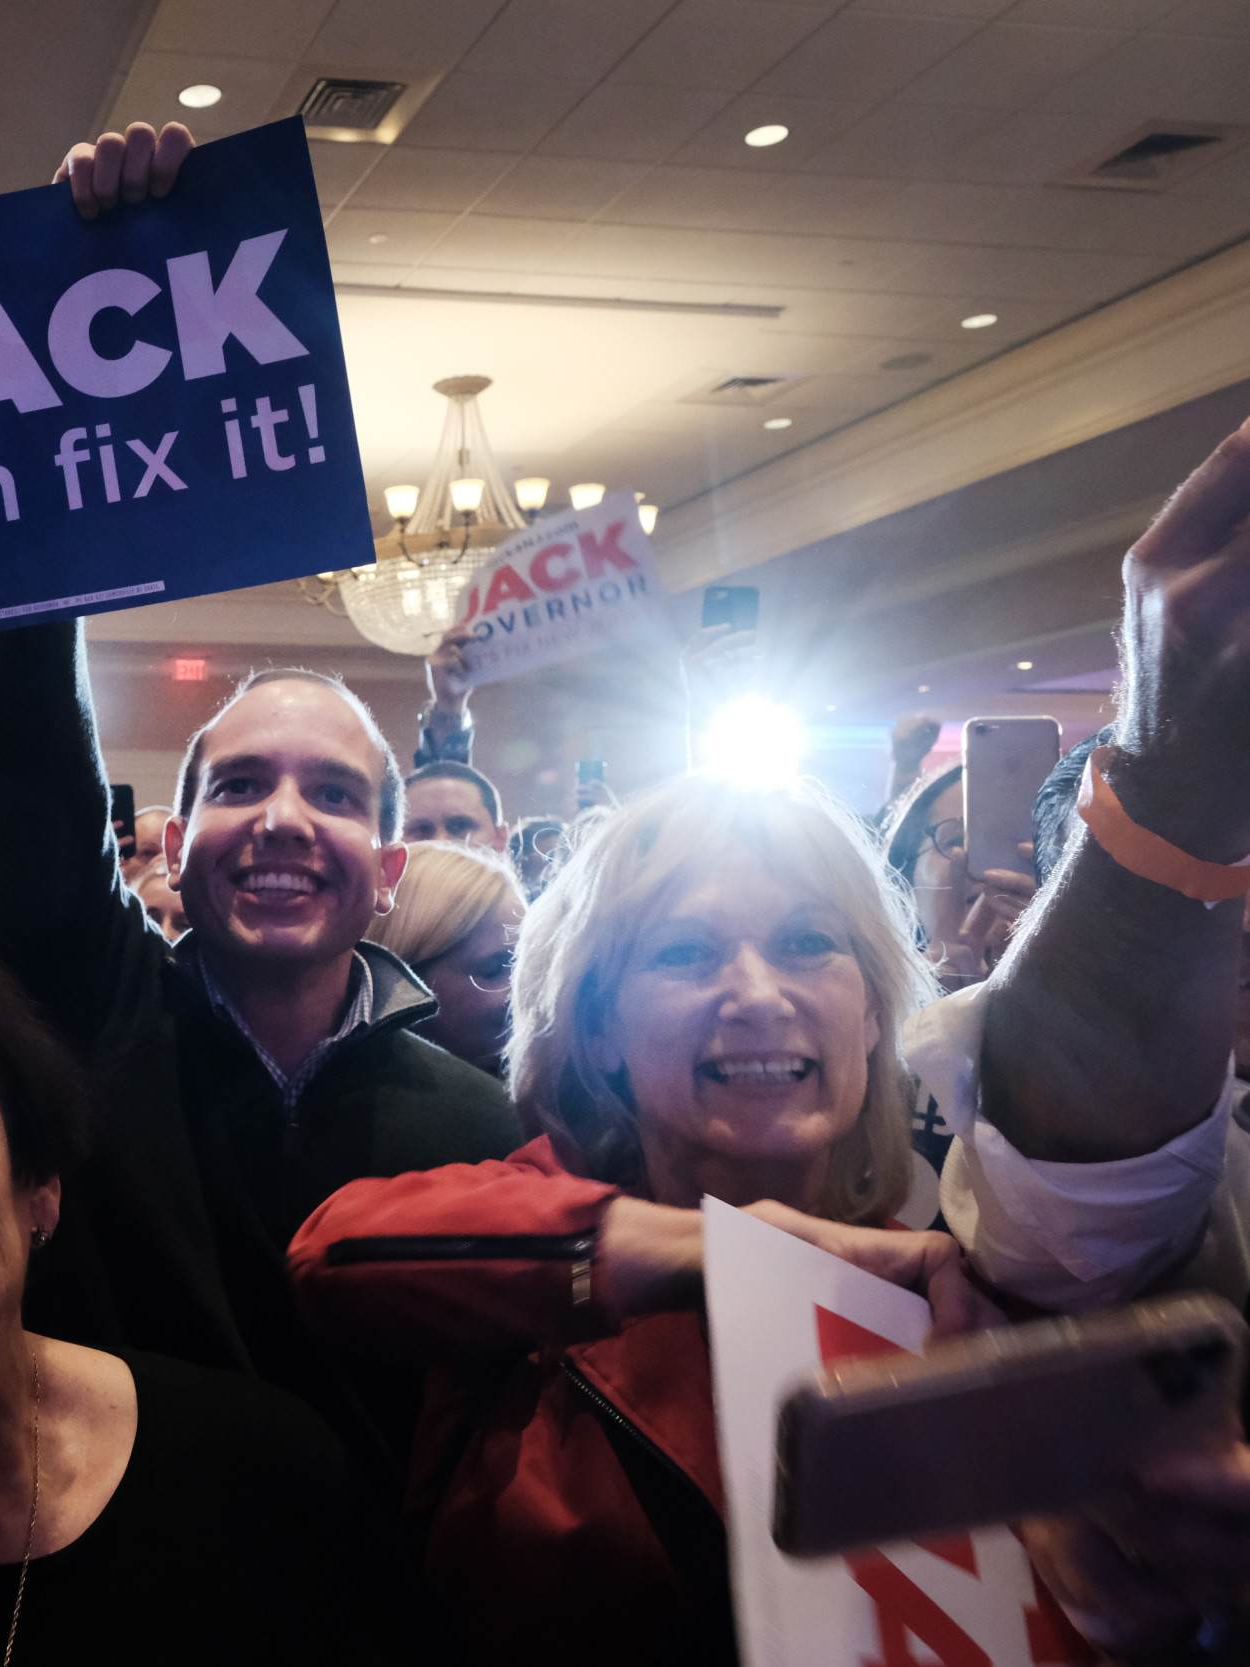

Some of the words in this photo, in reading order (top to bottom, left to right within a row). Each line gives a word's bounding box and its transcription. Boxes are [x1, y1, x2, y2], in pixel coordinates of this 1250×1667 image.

[54, 423, 188, 511] fix
[220, 384, 327, 480] it!
[461, 521, 639, 624] JACK
[472, 574, 647, 643] OVERNOR
[175, 659, 206, 680] EXIT
